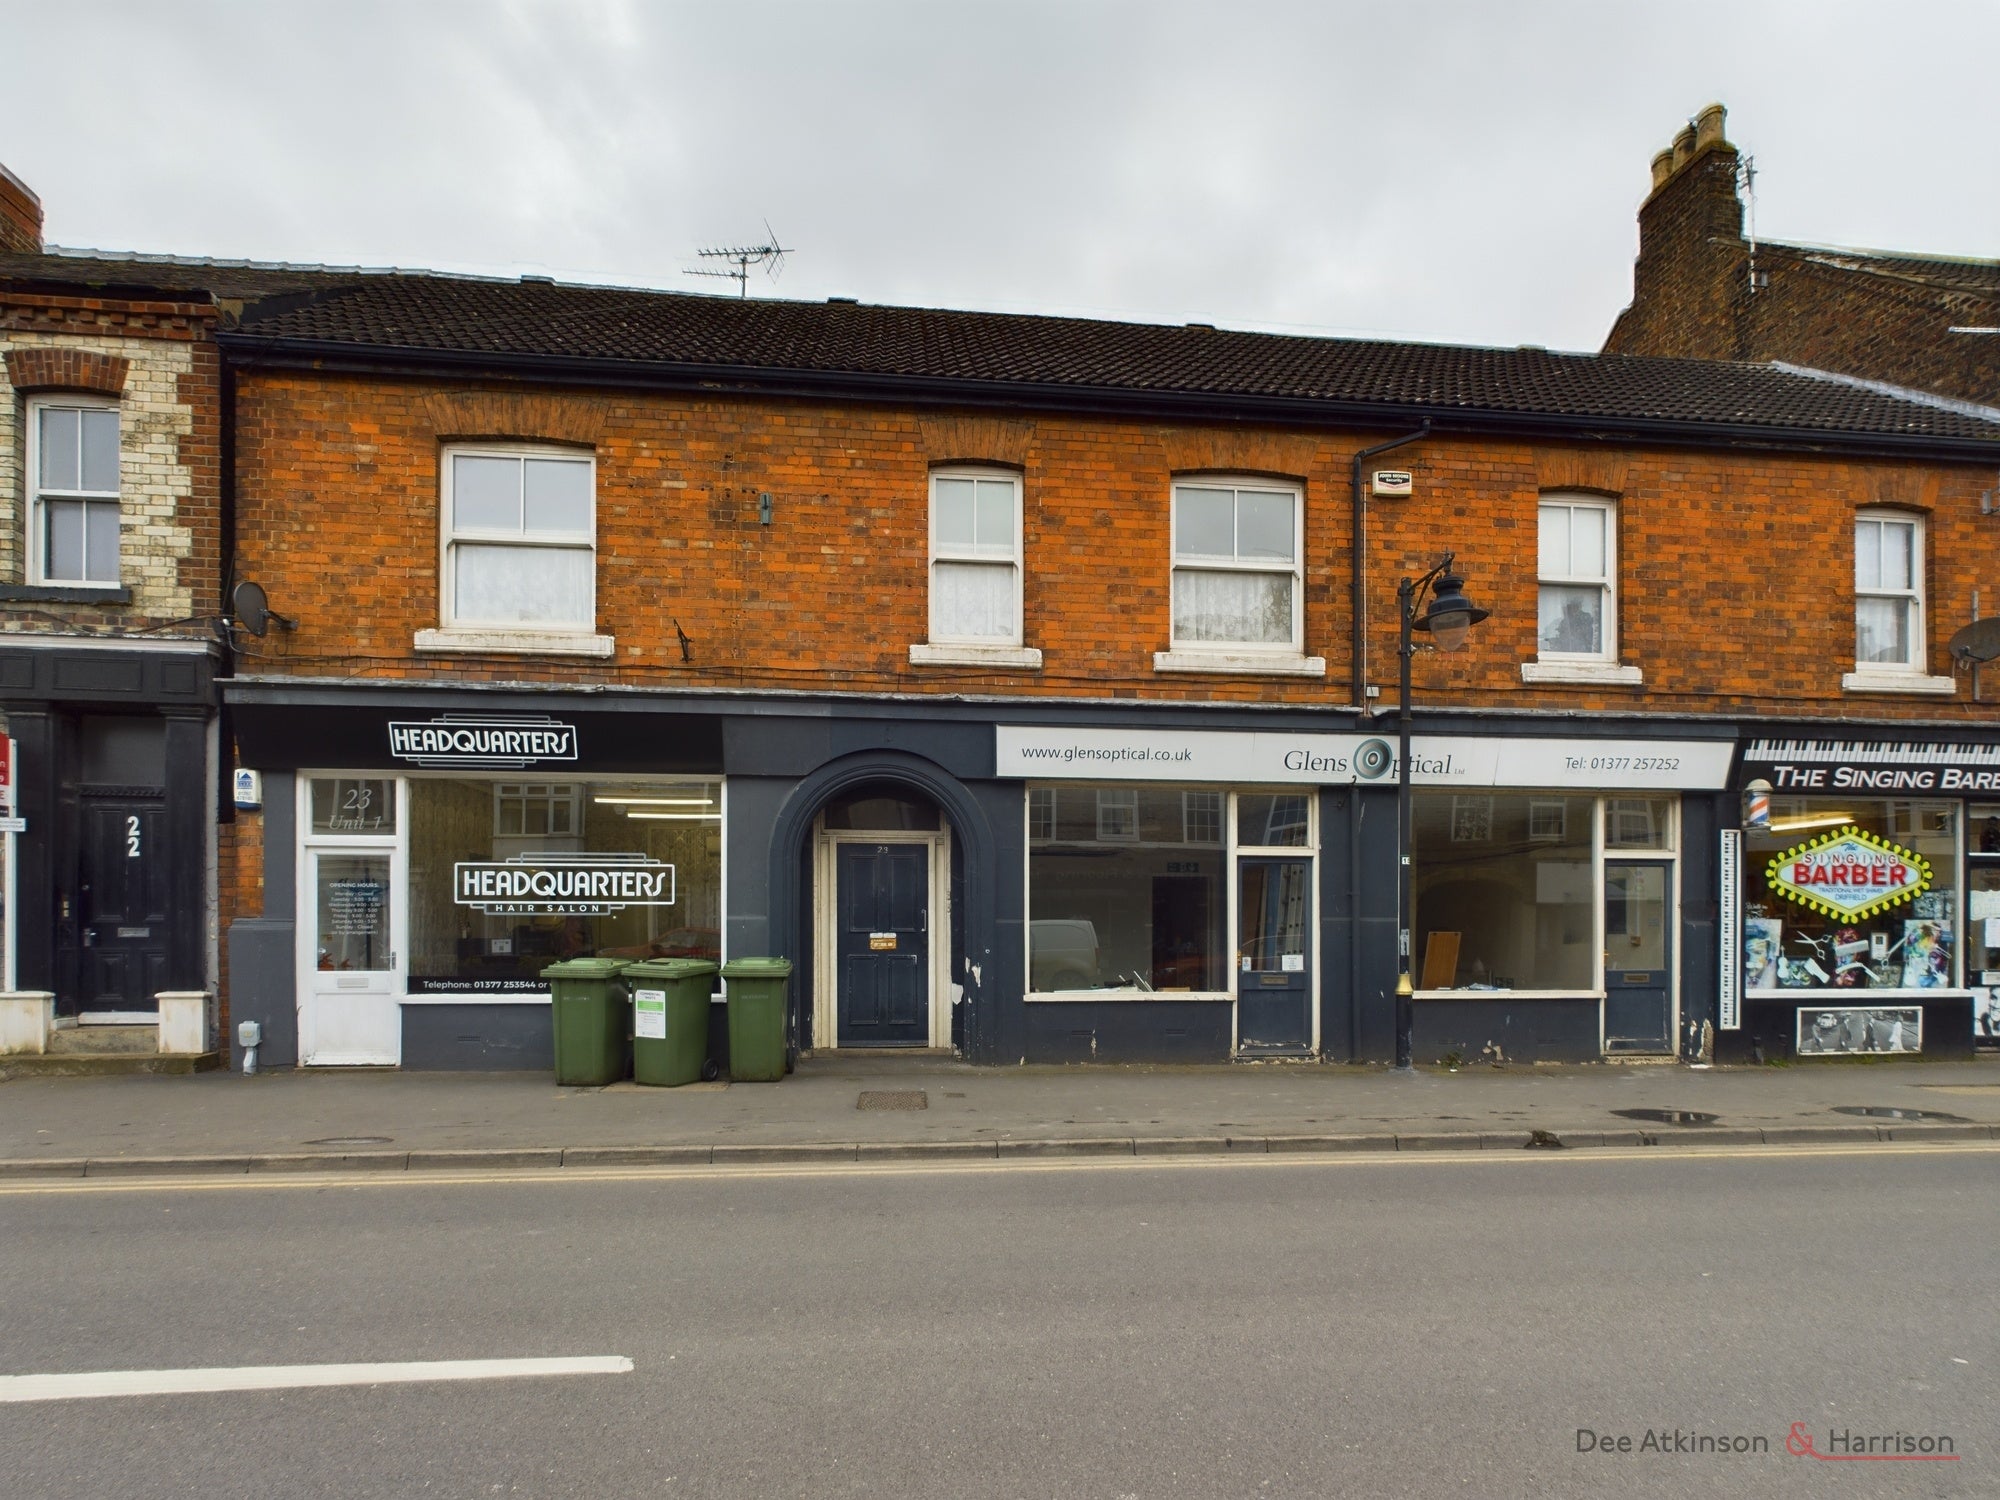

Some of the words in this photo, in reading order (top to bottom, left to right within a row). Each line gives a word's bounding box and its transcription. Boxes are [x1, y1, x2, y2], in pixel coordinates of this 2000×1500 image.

[393, 728, 570, 754] HEADQUARTERS
[1021, 745, 1192, 763] www.glensoptical.co.uk
[1284, 750, 1348, 772] Glens
[1565, 756, 1586, 769] Tel:
[1590, 757, 1630, 770] 01377
[1633, 758, 1680, 770] 257252
[1774, 765, 1827, 787] THE
[1832, 766, 1936, 789] SINGING
[342, 788, 373, 809] 23
[329, 815, 365, 830] Unit
[373, 816, 382, 830] 1
[1804, 854, 1897, 864] SINGING
[463, 870, 666, 897] HEADQUARTERS
[1793, 863, 1908, 886] BARBER
[495, 904, 535, 912] HAIR
[547, 904, 600, 913] SALON
[423, 980, 472, 990] Telephone:
[474, 981, 501, 989] 01377
[503, 981, 536, 989] 253544
